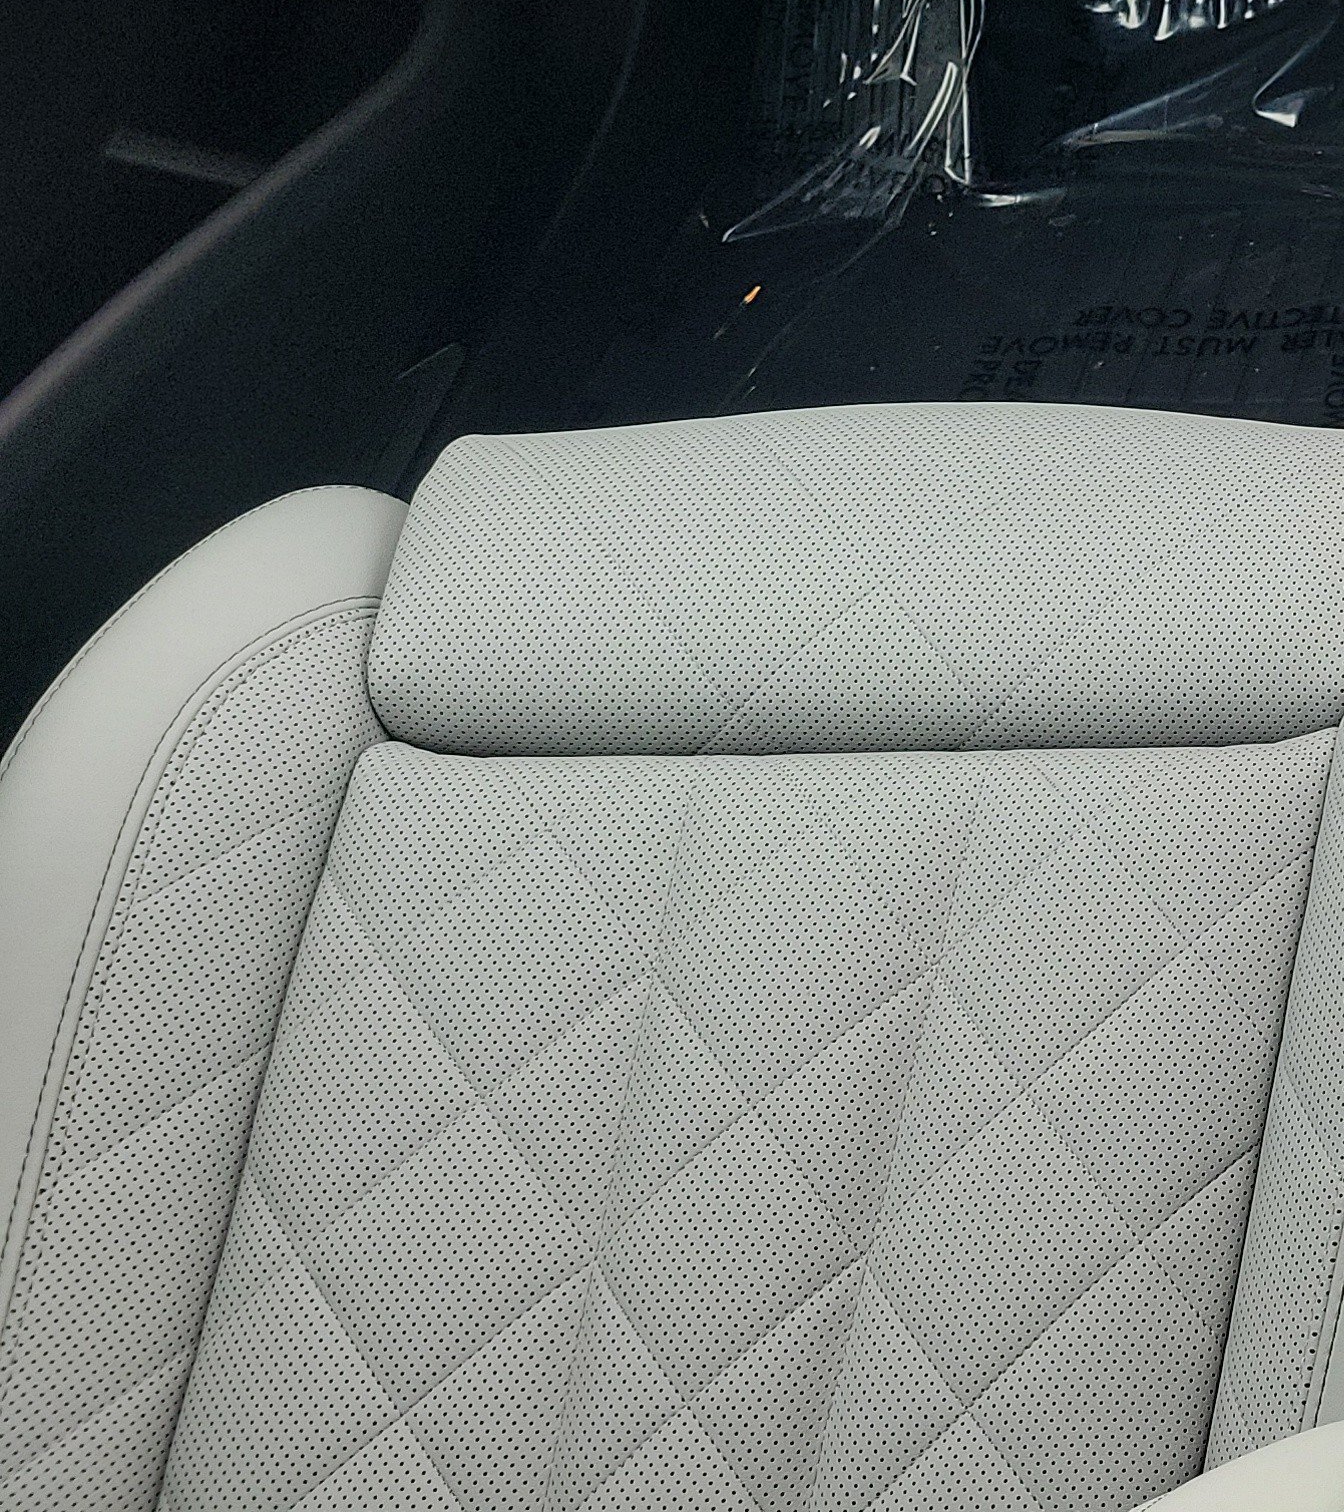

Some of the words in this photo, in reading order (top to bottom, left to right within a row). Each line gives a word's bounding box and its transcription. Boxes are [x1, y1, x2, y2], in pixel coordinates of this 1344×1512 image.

[1073, 305, 1194, 332] COVER
[979, 331, 1134, 358] REMOVE
[1157, 334, 1258, 358] MUST
